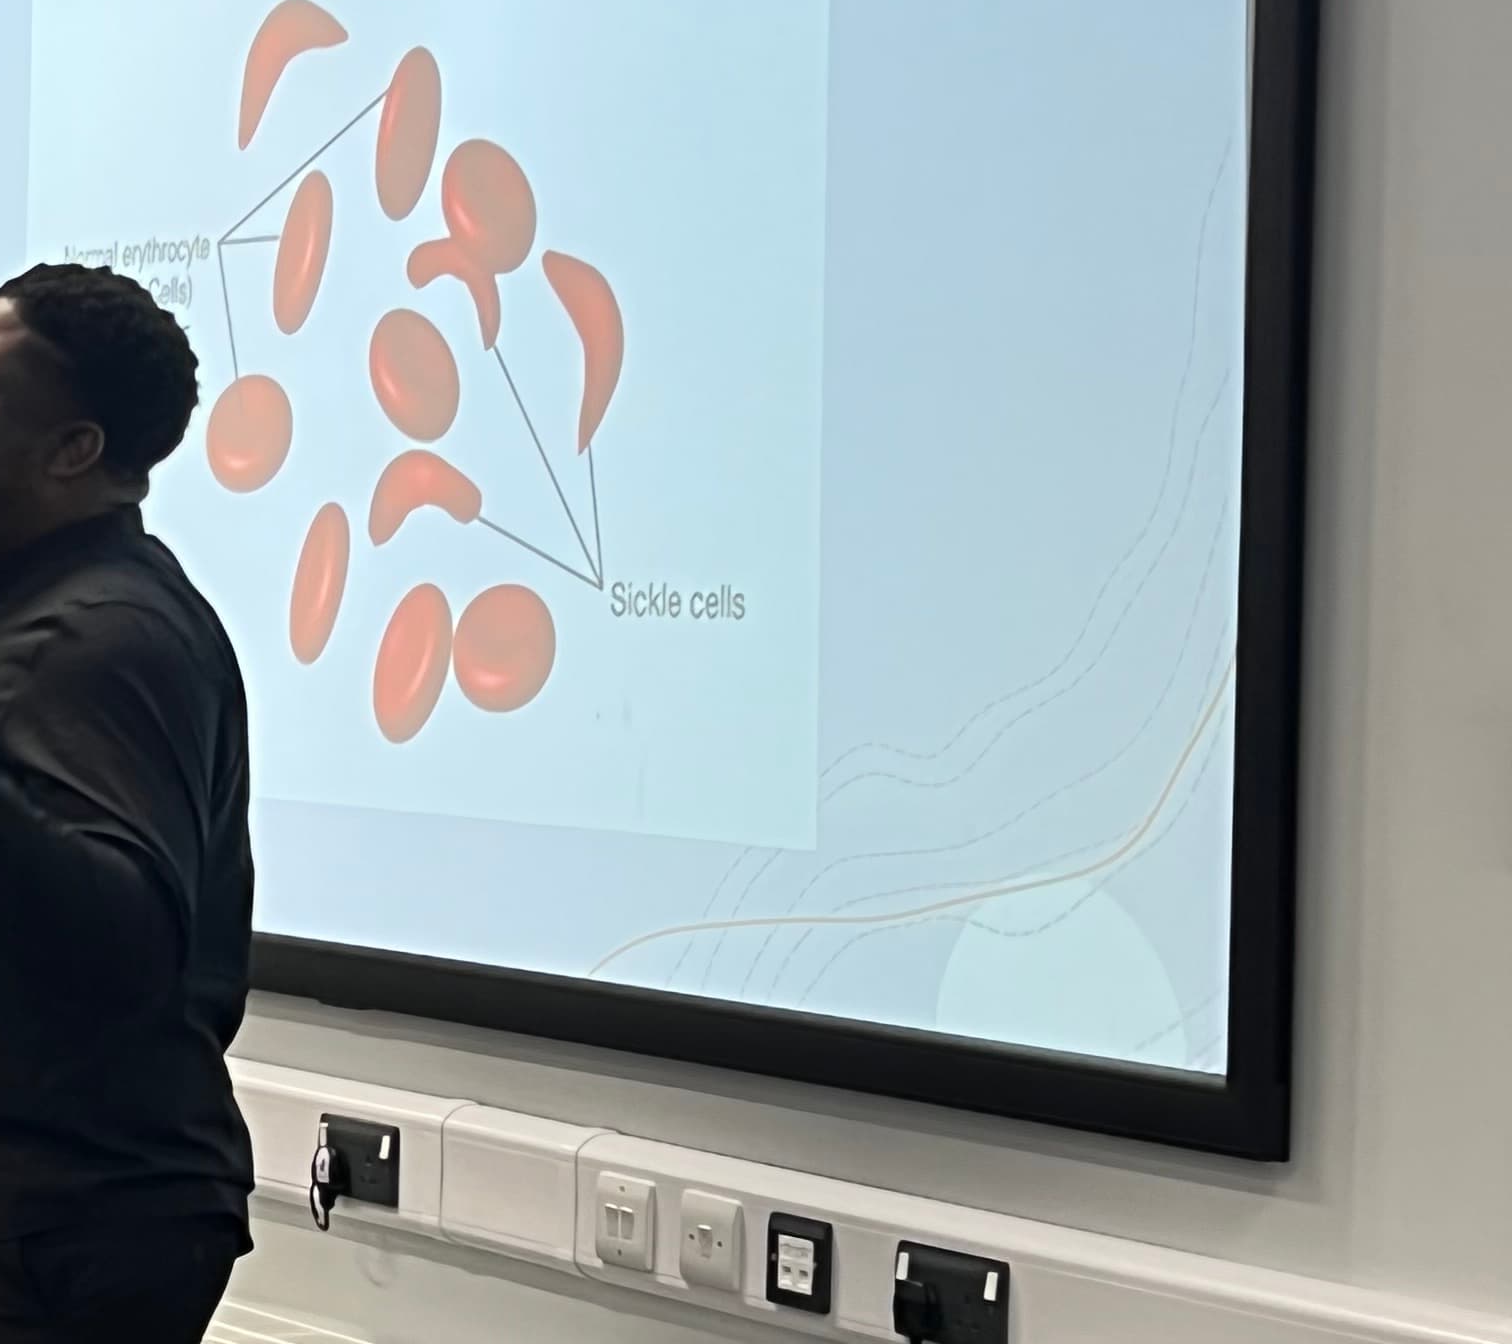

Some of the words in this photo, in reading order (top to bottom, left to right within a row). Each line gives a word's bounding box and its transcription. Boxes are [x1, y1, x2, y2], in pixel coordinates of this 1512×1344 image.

[122, 234, 211, 273] erythrocyte
[610, 581, 682, 618] Sickle
[690, 584, 746, 620] cells
